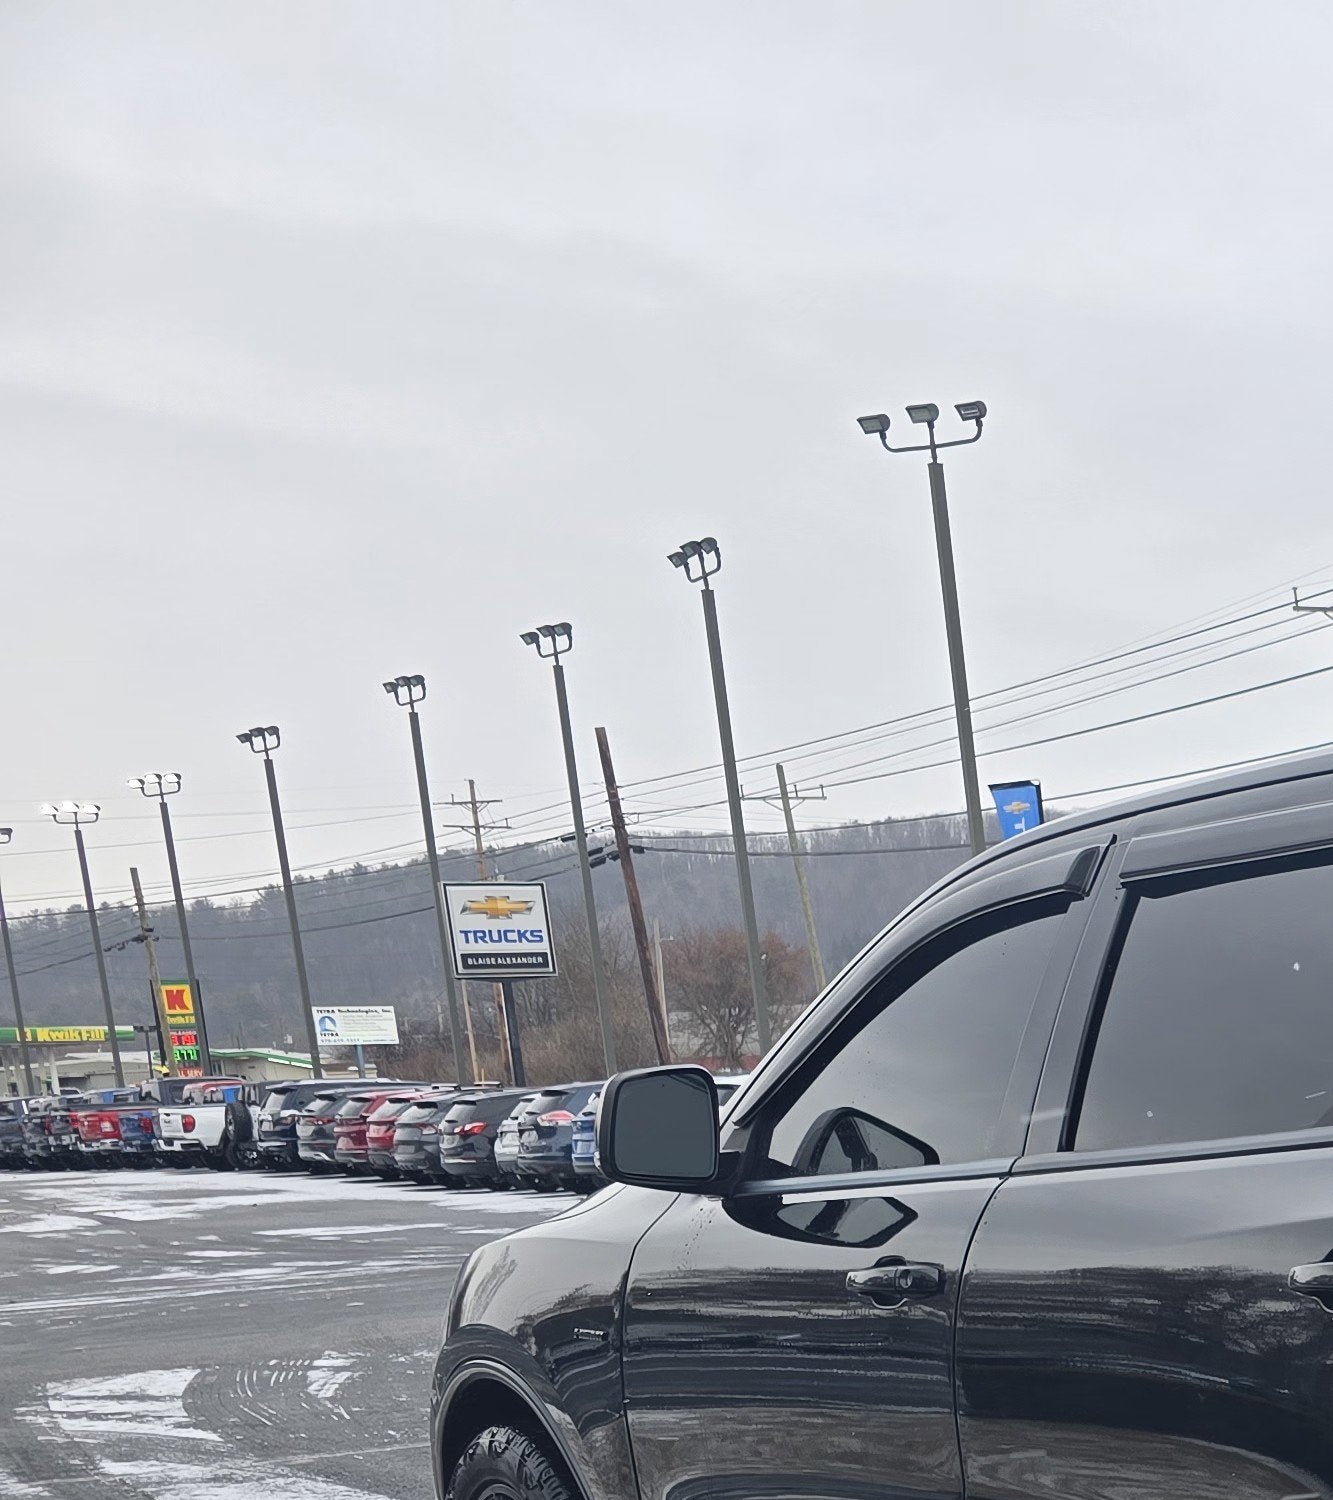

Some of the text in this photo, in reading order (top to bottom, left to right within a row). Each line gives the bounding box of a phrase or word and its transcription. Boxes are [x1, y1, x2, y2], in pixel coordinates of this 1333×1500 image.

[459, 929, 544, 944] TRUCKS
[467, 956, 543, 965] BLAISE ALEXANDER
[165, 989, 190, 1011] K
[36, 1028, 105, 1041] Kwik Fill
